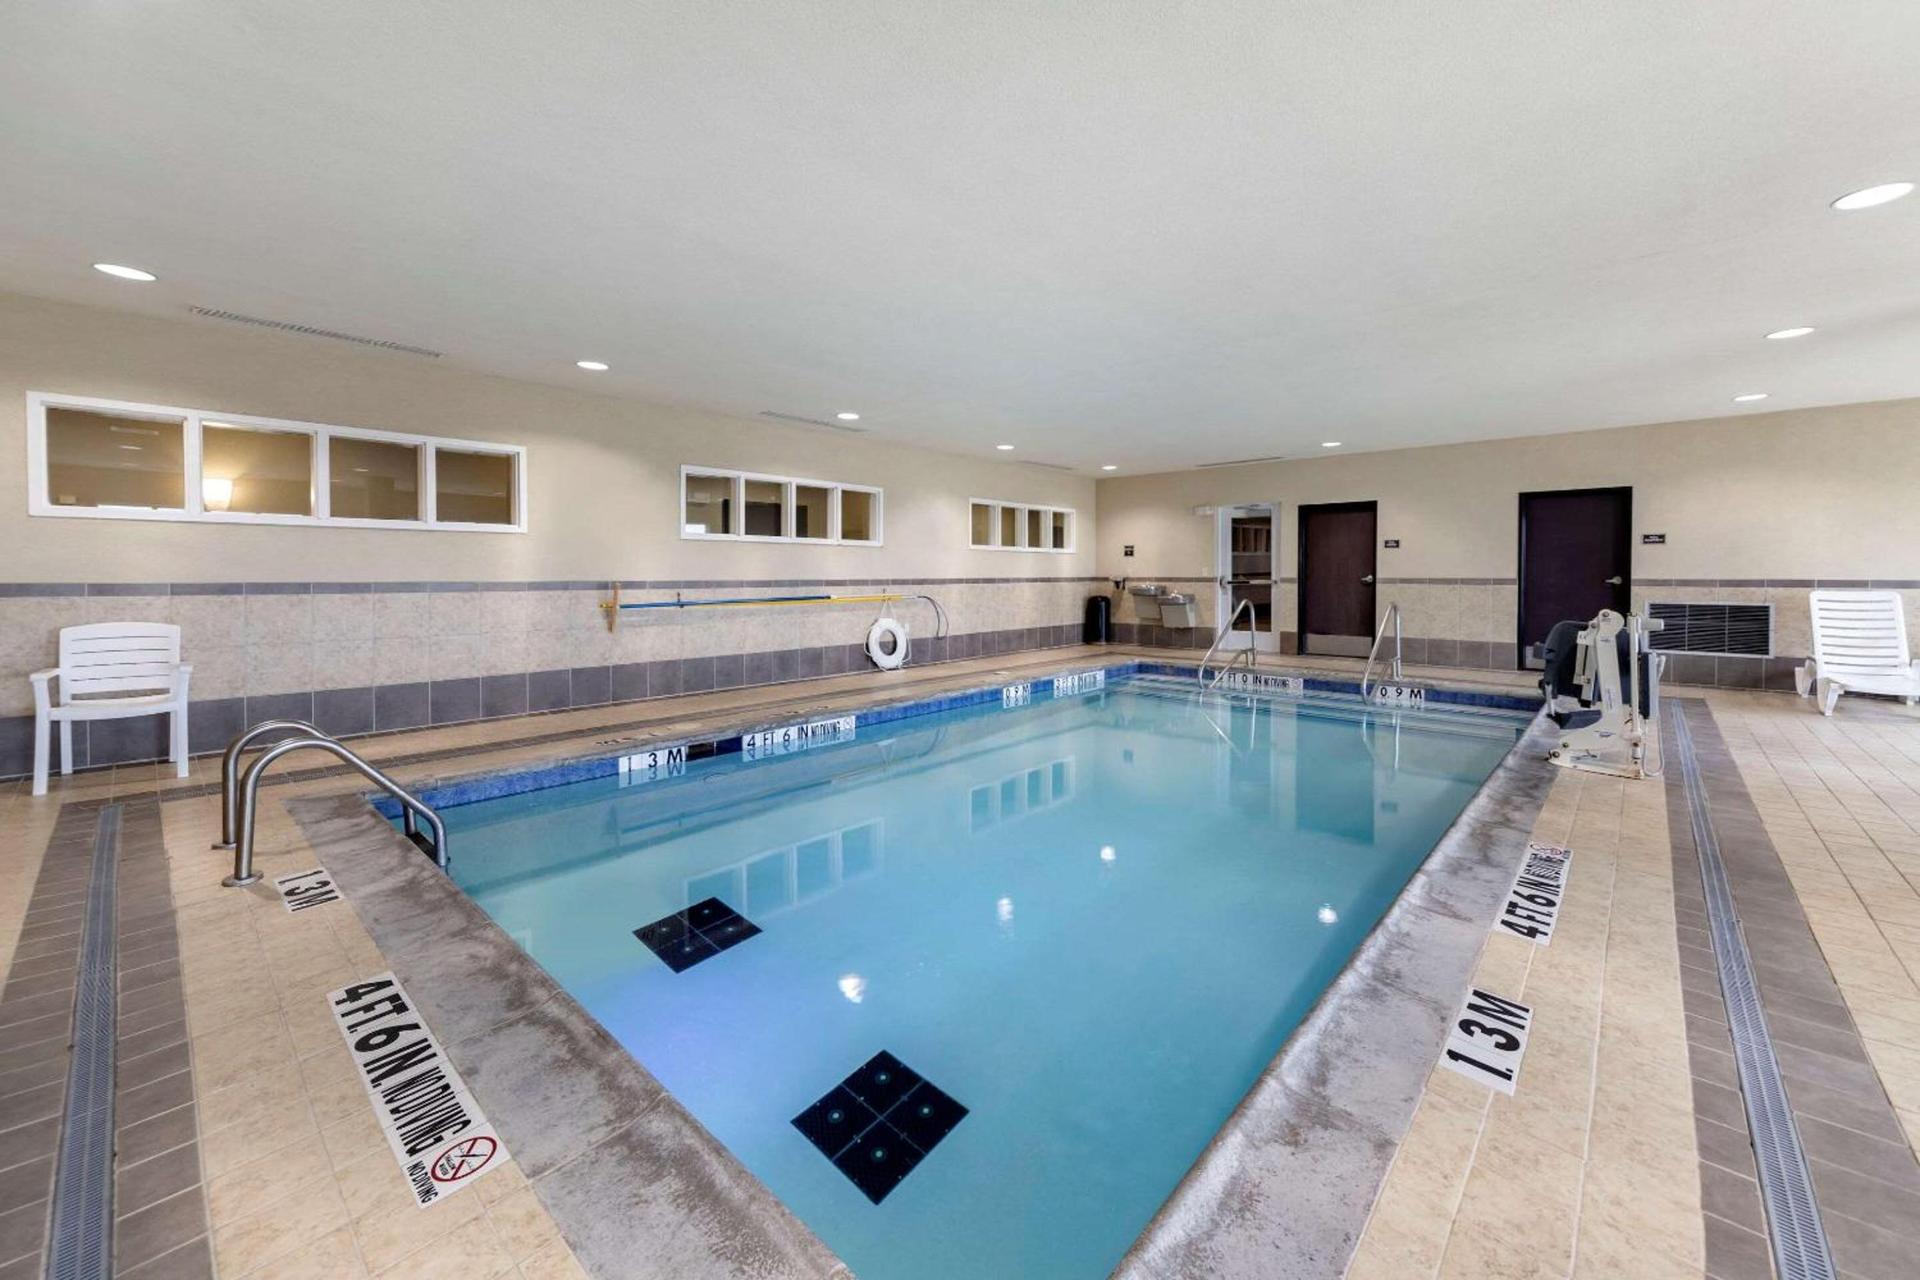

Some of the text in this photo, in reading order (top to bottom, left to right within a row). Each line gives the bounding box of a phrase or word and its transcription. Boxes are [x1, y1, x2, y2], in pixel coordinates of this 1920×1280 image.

[1410, 689, 1422, 699] M
[747, 734, 756, 747] 4
[763, 732, 774, 745] FT
[782, 729, 791, 742] 6
[797, 725, 809, 739] IN
[648, 752, 657, 768] 3
[667, 748, 682, 764] M
[1513, 889, 1557, 908] 6
[1501, 919, 1549, 939] 4
[335, 980, 394, 1005] 4
[354, 1022, 421, 1052] 6
